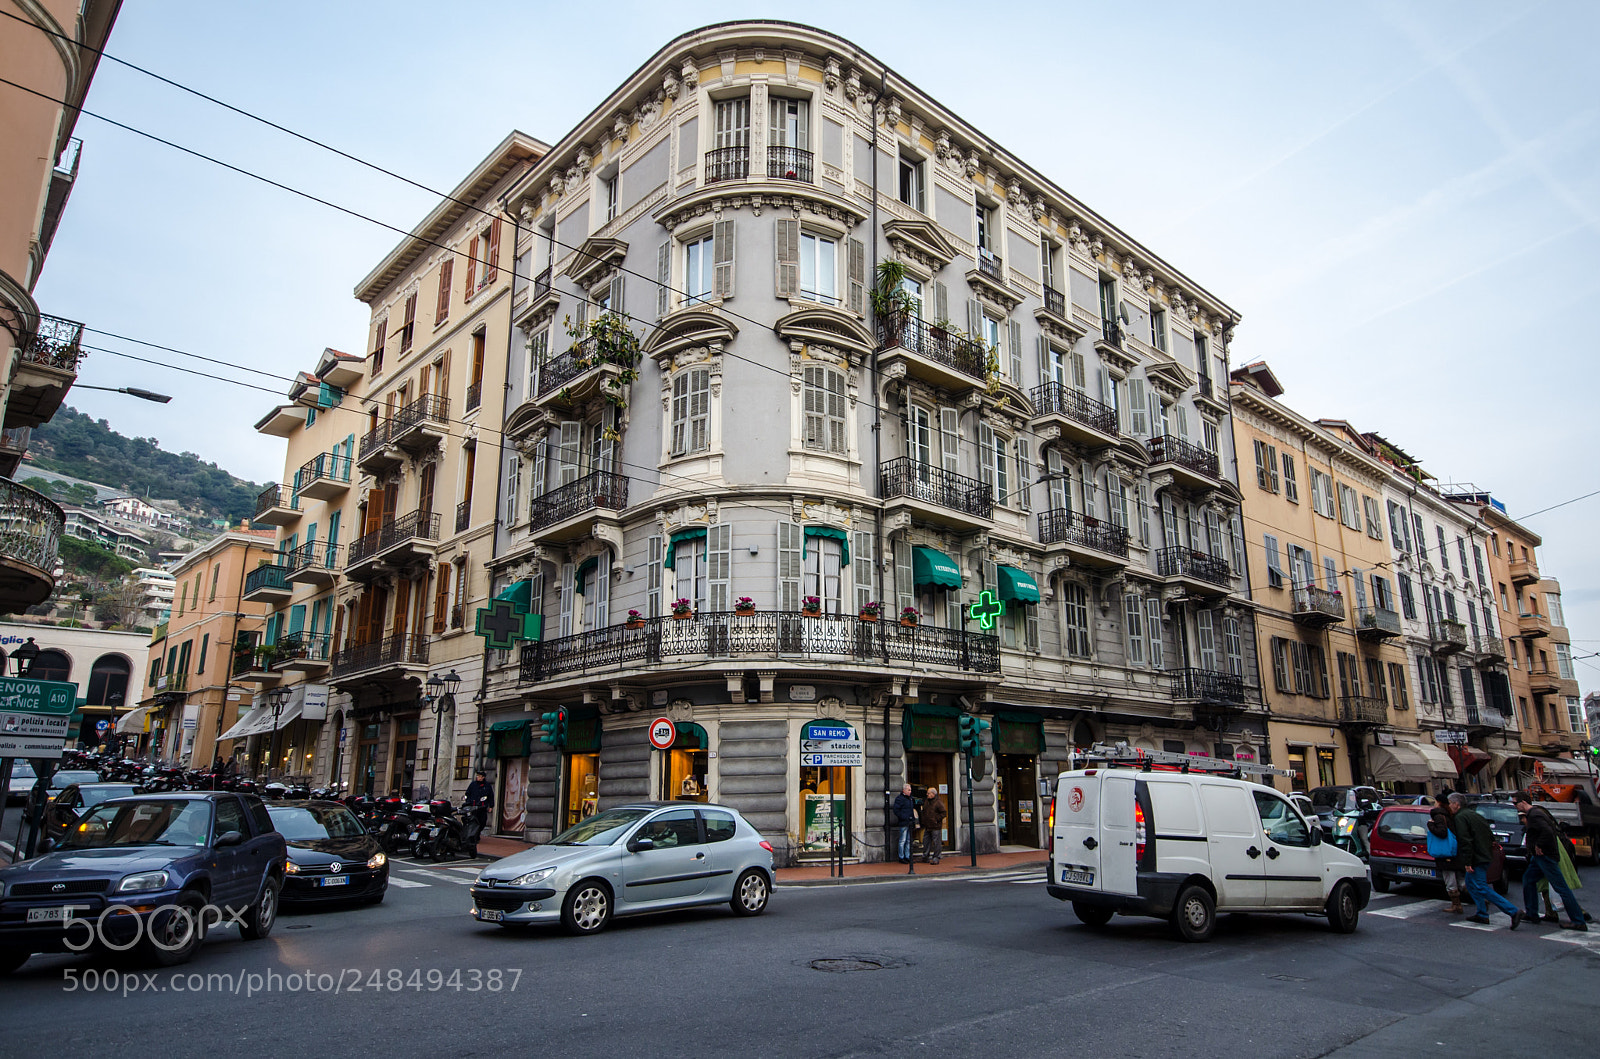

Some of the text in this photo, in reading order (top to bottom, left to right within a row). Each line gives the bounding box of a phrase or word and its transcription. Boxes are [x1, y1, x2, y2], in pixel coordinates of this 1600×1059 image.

[50, 693, 67, 703] A10
[21, 716, 67, 727] polizia locale
[813, 729, 827, 737] SAN
[830, 742, 861, 750] stazione
